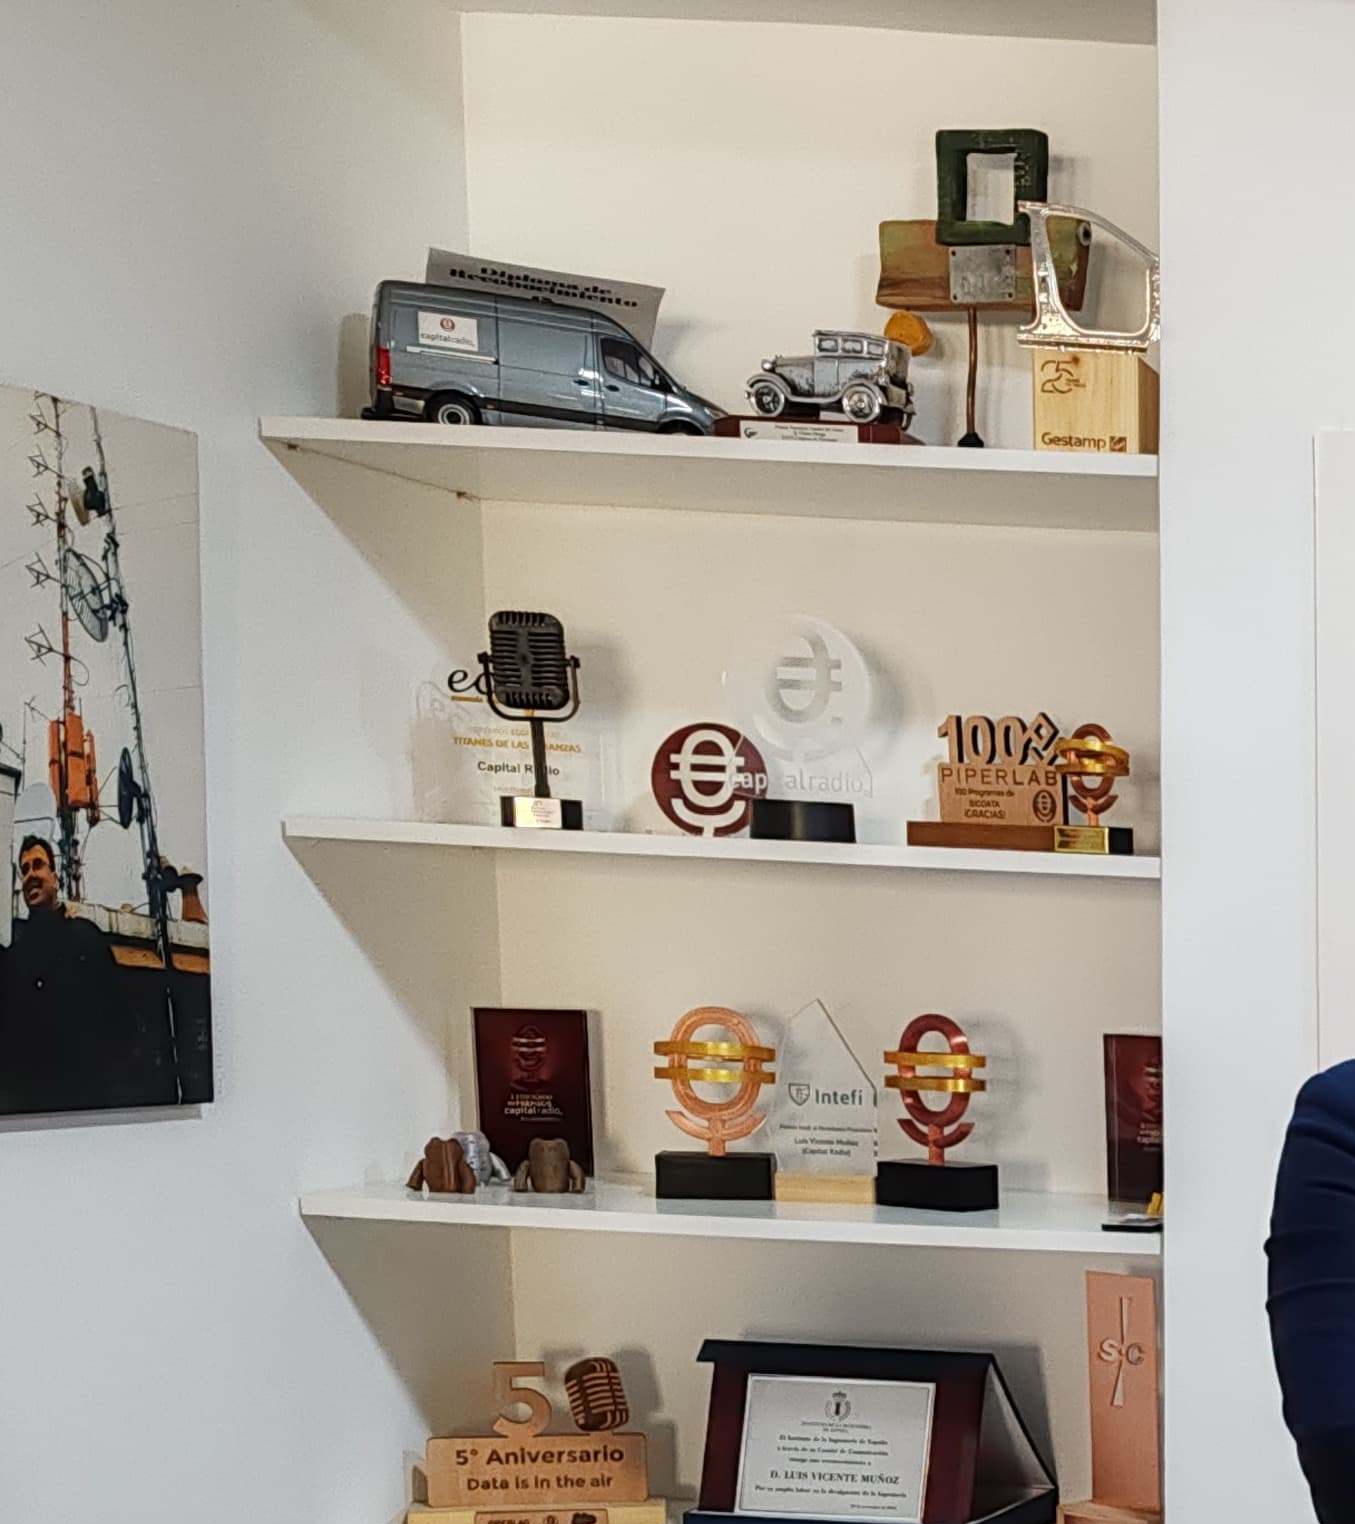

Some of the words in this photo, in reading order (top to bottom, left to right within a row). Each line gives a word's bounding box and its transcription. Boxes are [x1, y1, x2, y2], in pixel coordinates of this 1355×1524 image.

[1041, 432, 1107, 452] Gestamp
[477, 760, 521, 774] Capital
[941, 767, 1058, 787] PIPERLAB
[815, 1089, 863, 1106] Intefi
[486, 1445, 624, 1465] Aniversario
[467, 1477, 509, 1491] Data
[515, 1475, 530, 1490] is
[534, 1475, 551, 1489] in
[556, 1475, 586, 1489] the
[590, 1473, 613, 1488] air
[784, 1470, 809, 1480] LUIS
[811, 1472, 858, 1483] VICENTE
[861, 1473, 900, 1485] MUÑOZ
